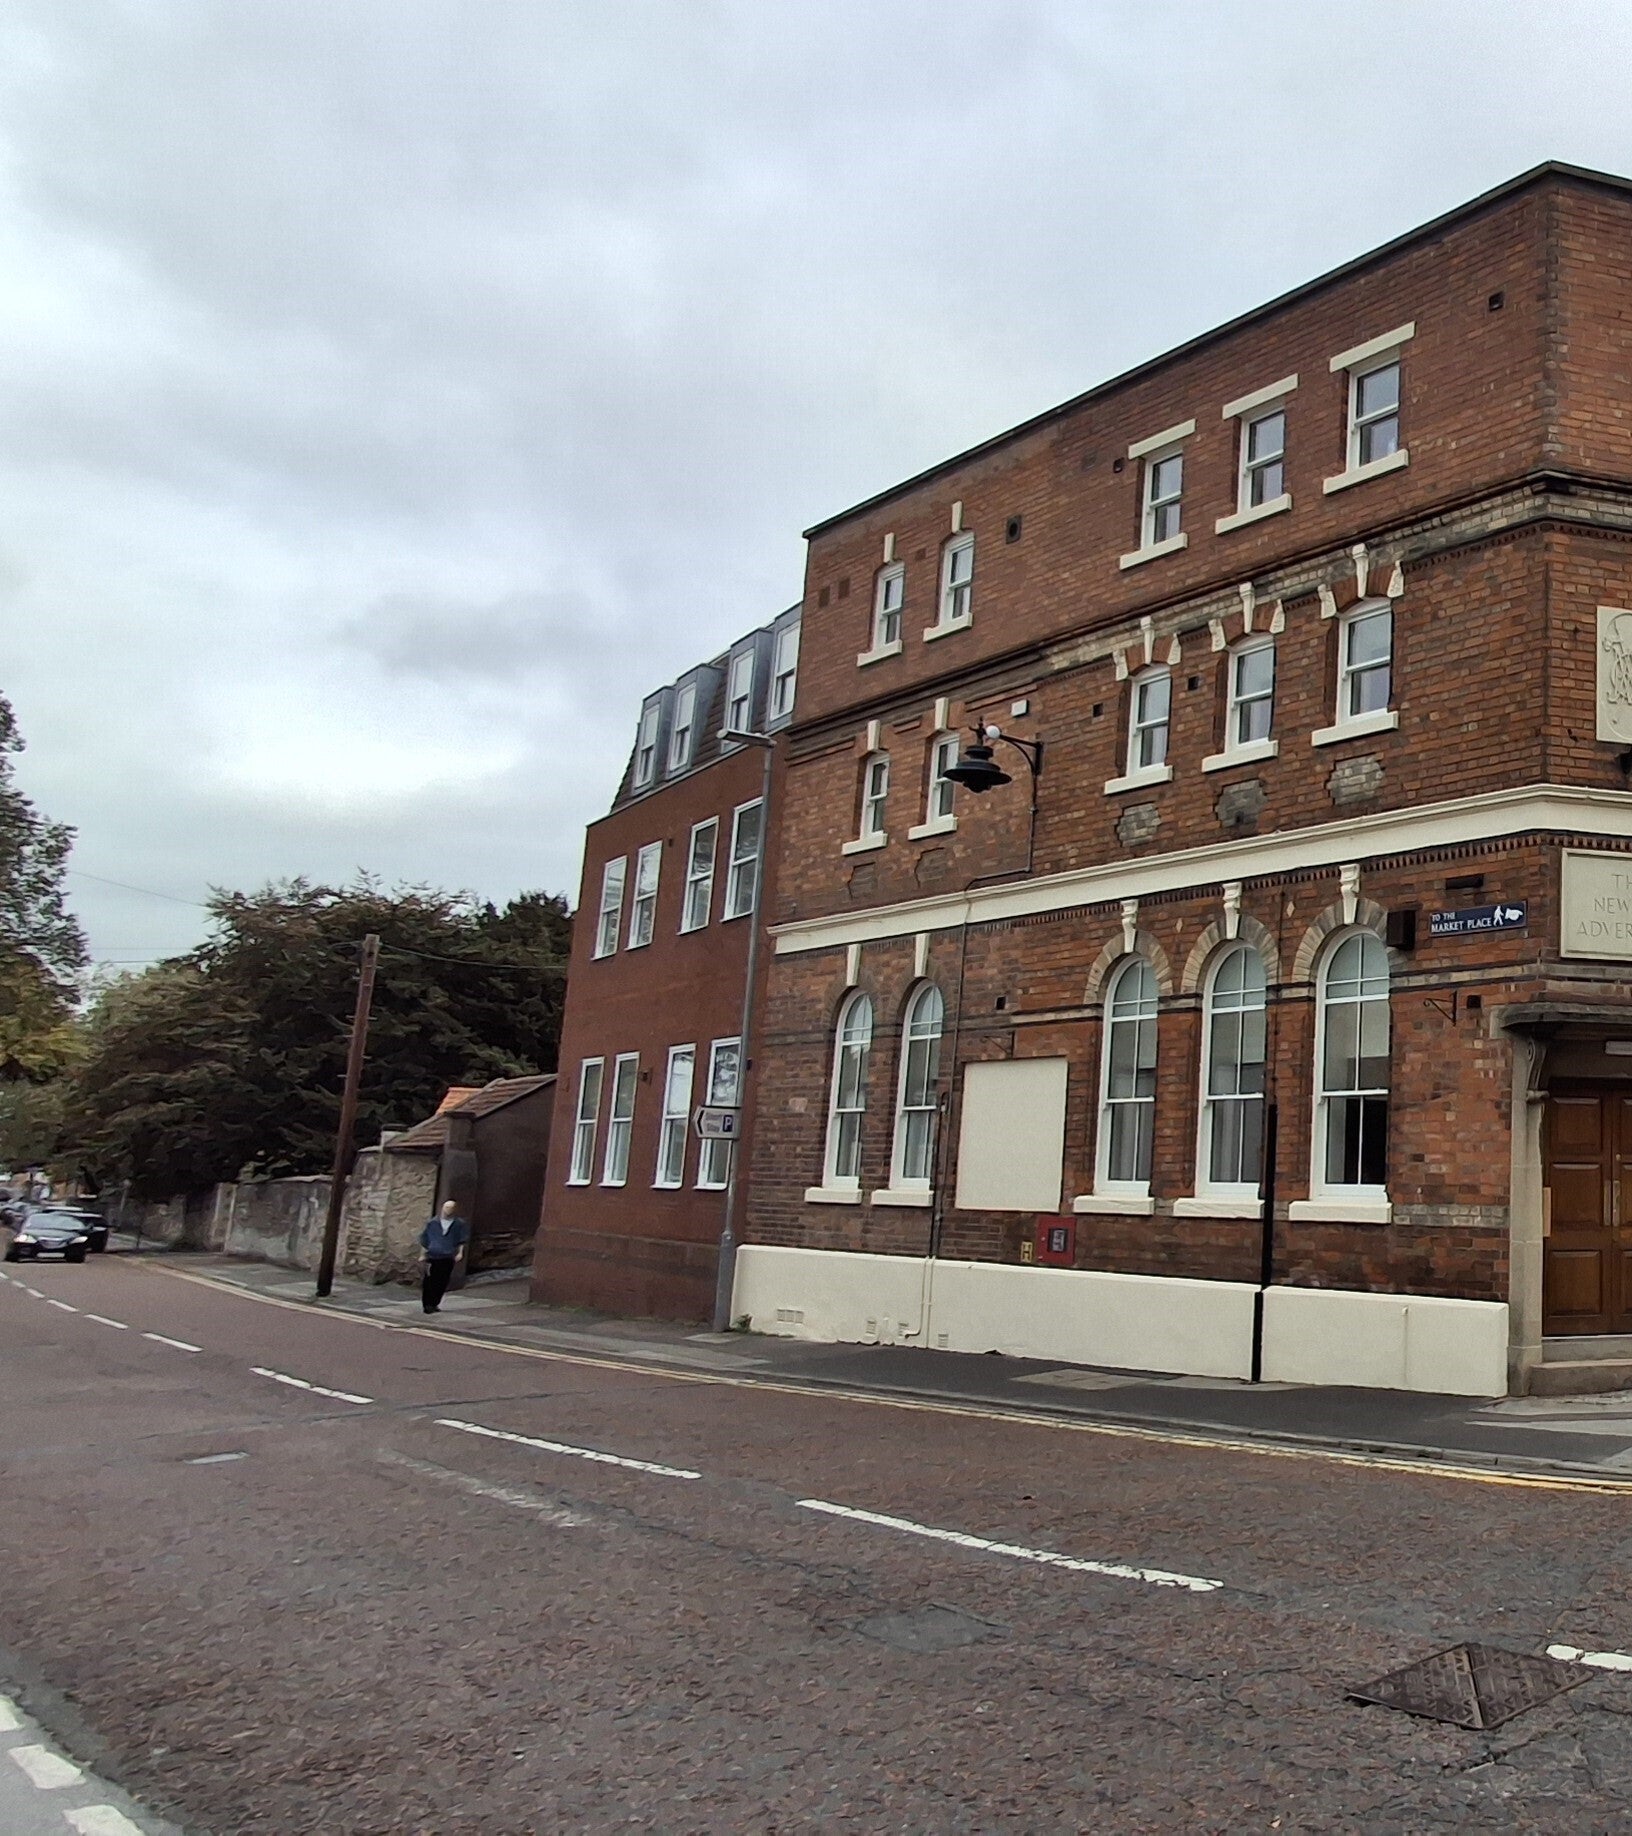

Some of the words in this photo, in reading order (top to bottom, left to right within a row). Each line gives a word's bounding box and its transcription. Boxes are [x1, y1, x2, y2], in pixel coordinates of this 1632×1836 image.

[1432, 914, 1441, 922] TO
[1443, 912, 1456, 920] THE
[1431, 921, 1464, 933] MARKET
[1467, 918, 1492, 930] PLACE
